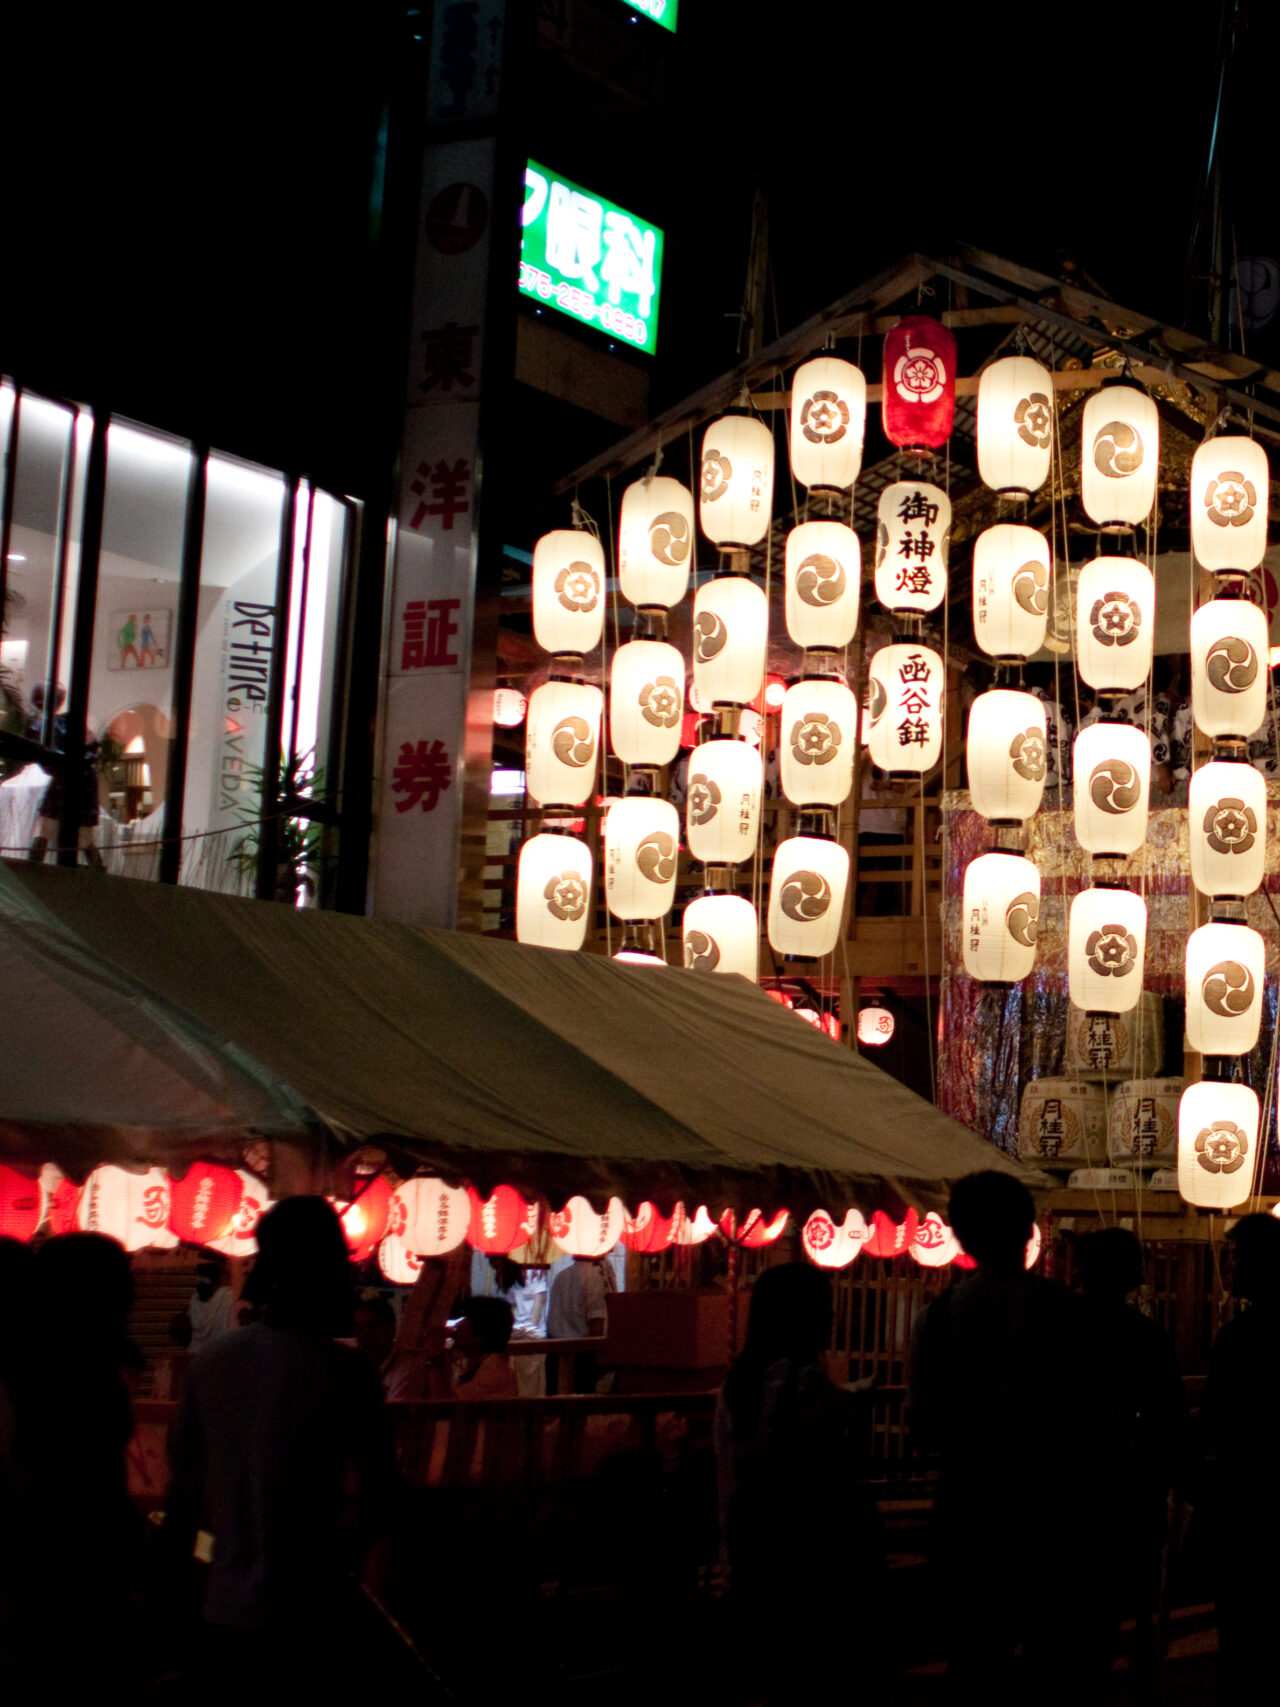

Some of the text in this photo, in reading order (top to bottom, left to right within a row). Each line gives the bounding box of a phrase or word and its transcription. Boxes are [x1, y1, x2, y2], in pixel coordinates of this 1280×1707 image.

[391, 322, 480, 812] 東洋証券
[895, 491, 939, 595] 御神燈
[219, 716, 245, 812] AVEDA
[1038, 1098, 1065, 1157] 月桂冠
[1132, 1098, 1159, 1156] 月桂冠
